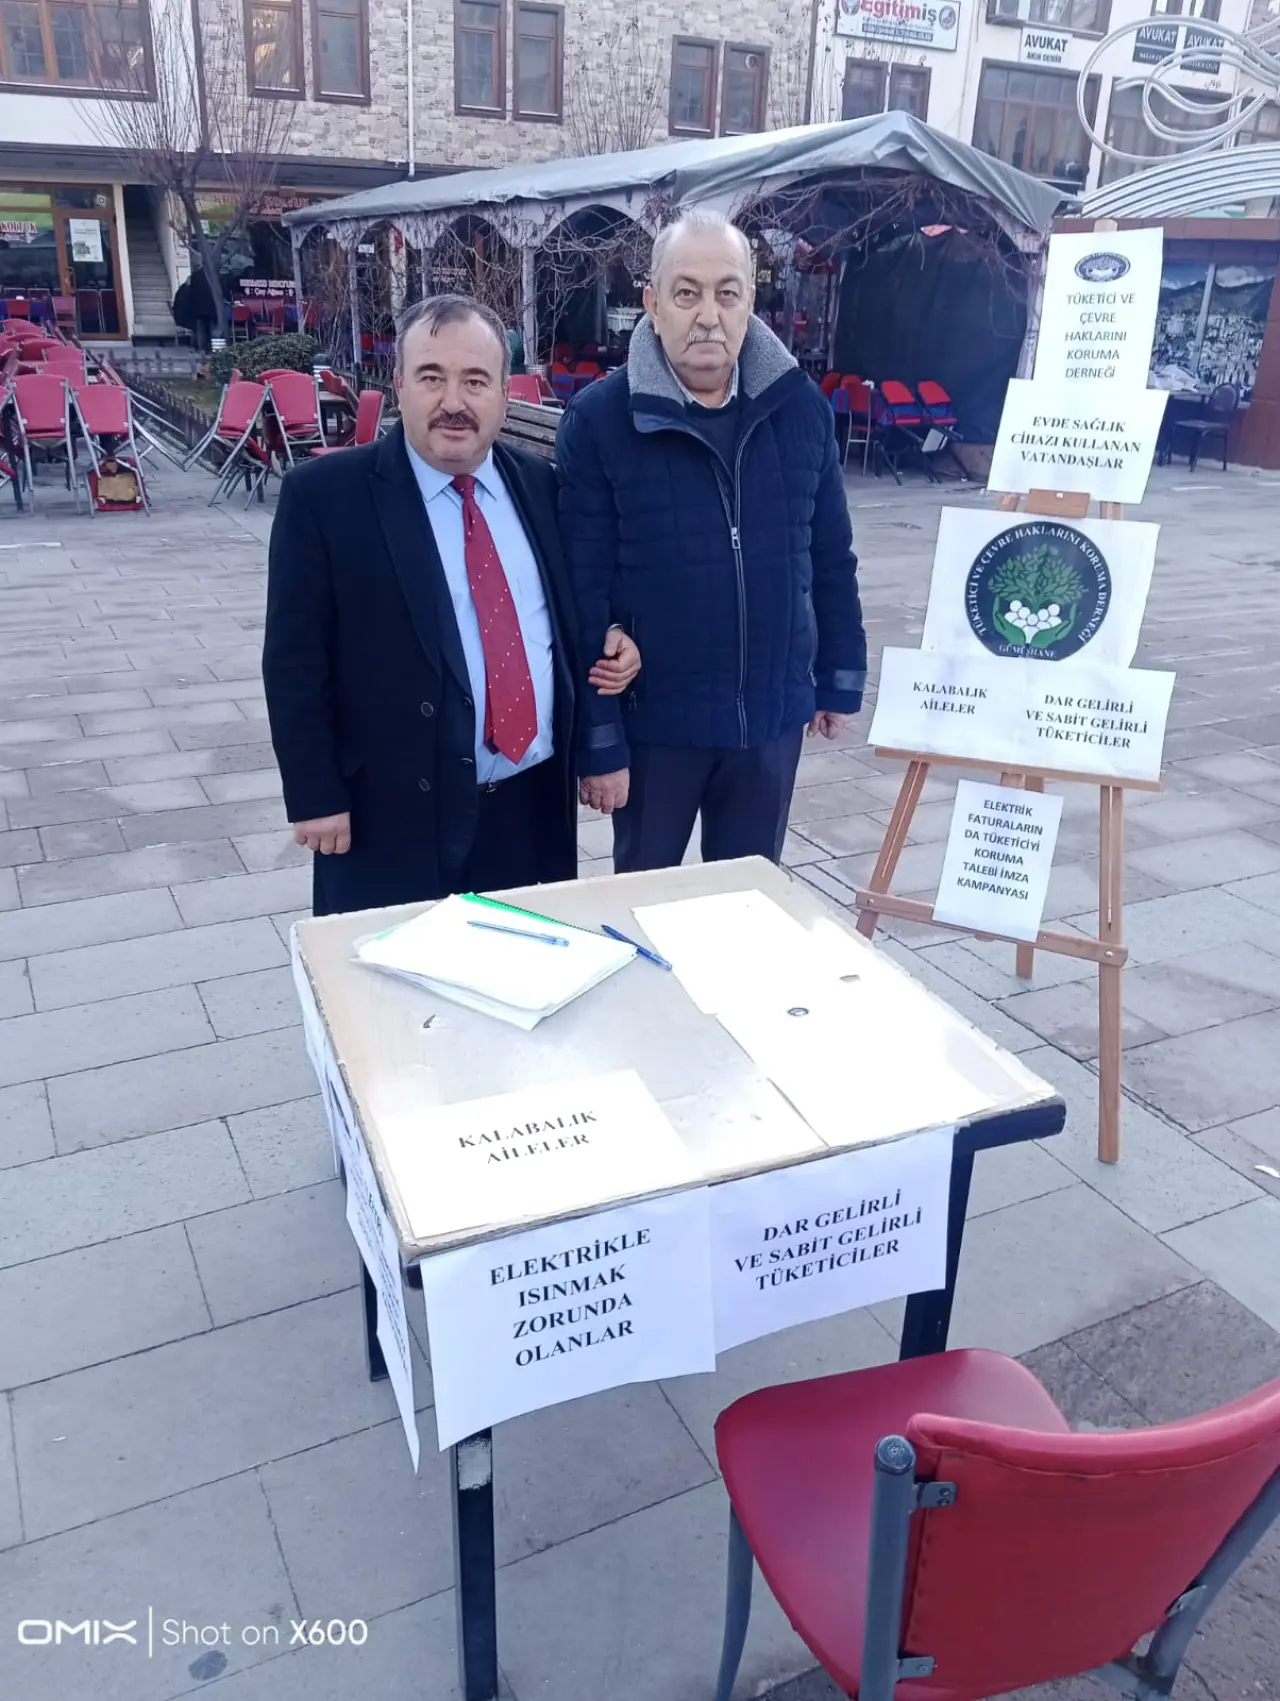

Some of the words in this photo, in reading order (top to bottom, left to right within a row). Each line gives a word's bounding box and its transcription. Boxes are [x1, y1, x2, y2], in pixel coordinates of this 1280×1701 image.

[1024, 34, 1068, 52] AVUKAT
[1139, 27, 1177, 43] AVUKAT
[1187, 34, 1224, 48] AVUKAT
[1066, 292, 1116, 305] TÜKETİCİ
[1120, 293, 1136, 304] VE
[1080, 312, 1116, 325] ÇEVRE
[1065, 331, 1127, 341] HAKLARINI
[1067, 349, 1120, 360] KORUMA
[1065, 366, 1116, 378] DERNEĞİ
[1032, 416, 1070, 429] EVDE
[1072, 417, 1126, 433] SAĞLIK
[1011, 431, 1059, 446] CİHAZI
[1062, 437, 1142, 452] KULLANAN
[1021, 450, 1124, 469] VATANDAŞLAR
[972, 563, 984, 580] VE
[981, 534, 1014, 565] ÇEVRE
[1015, 525, 1080, 545] HAKLARINI
[1079, 542, 1107, 590] KORUMA
[912, 681, 988, 699] KALABALIK
[919, 699, 976, 715] AİLELER
[1044, 694, 1074, 708] DAR
[1076, 697, 1134, 714] GELİRLİ
[1025, 709, 1044, 722] VE
[1045, 711, 1088, 727] SABİT
[1090, 717, 1148, 734] GELİRLİ
[1036, 726, 1131, 749] TÜKETİCİLER
[983, 799, 1033, 817] ELEKTRİK
[968, 813, 1043, 835] FATURALARIN
[964, 829, 980, 840] DA
[983, 832, 1041, 852] TÜKETİCİYİ
[974, 847, 1024, 866] KORUMA
[962, 861, 998, 877] TALEBİ
[1000, 865, 1029, 884] İMZA
[957, 877, 1029, 900] KAMPANYASI
[459, 1111, 597, 1148] KALABALIK
[487, 1134, 589, 1164] AİLELER
[763, 1216, 809, 1242] DAR
[814, 1188, 902, 1230] GELİRLİ
[733, 1252, 763, 1273] VE
[768, 1236, 833, 1265] SABİT
[838, 1206, 923, 1247] GELİRLİ
[489, 1227, 652, 1287] ELEKTRİKLE
[755, 1238, 901, 1292] TÜKETİCİLER
[518, 1262, 627, 1308] ISINMAK
[512, 1292, 633, 1339] ZORUNDA
[515, 1319, 634, 1367] OLANLAR
